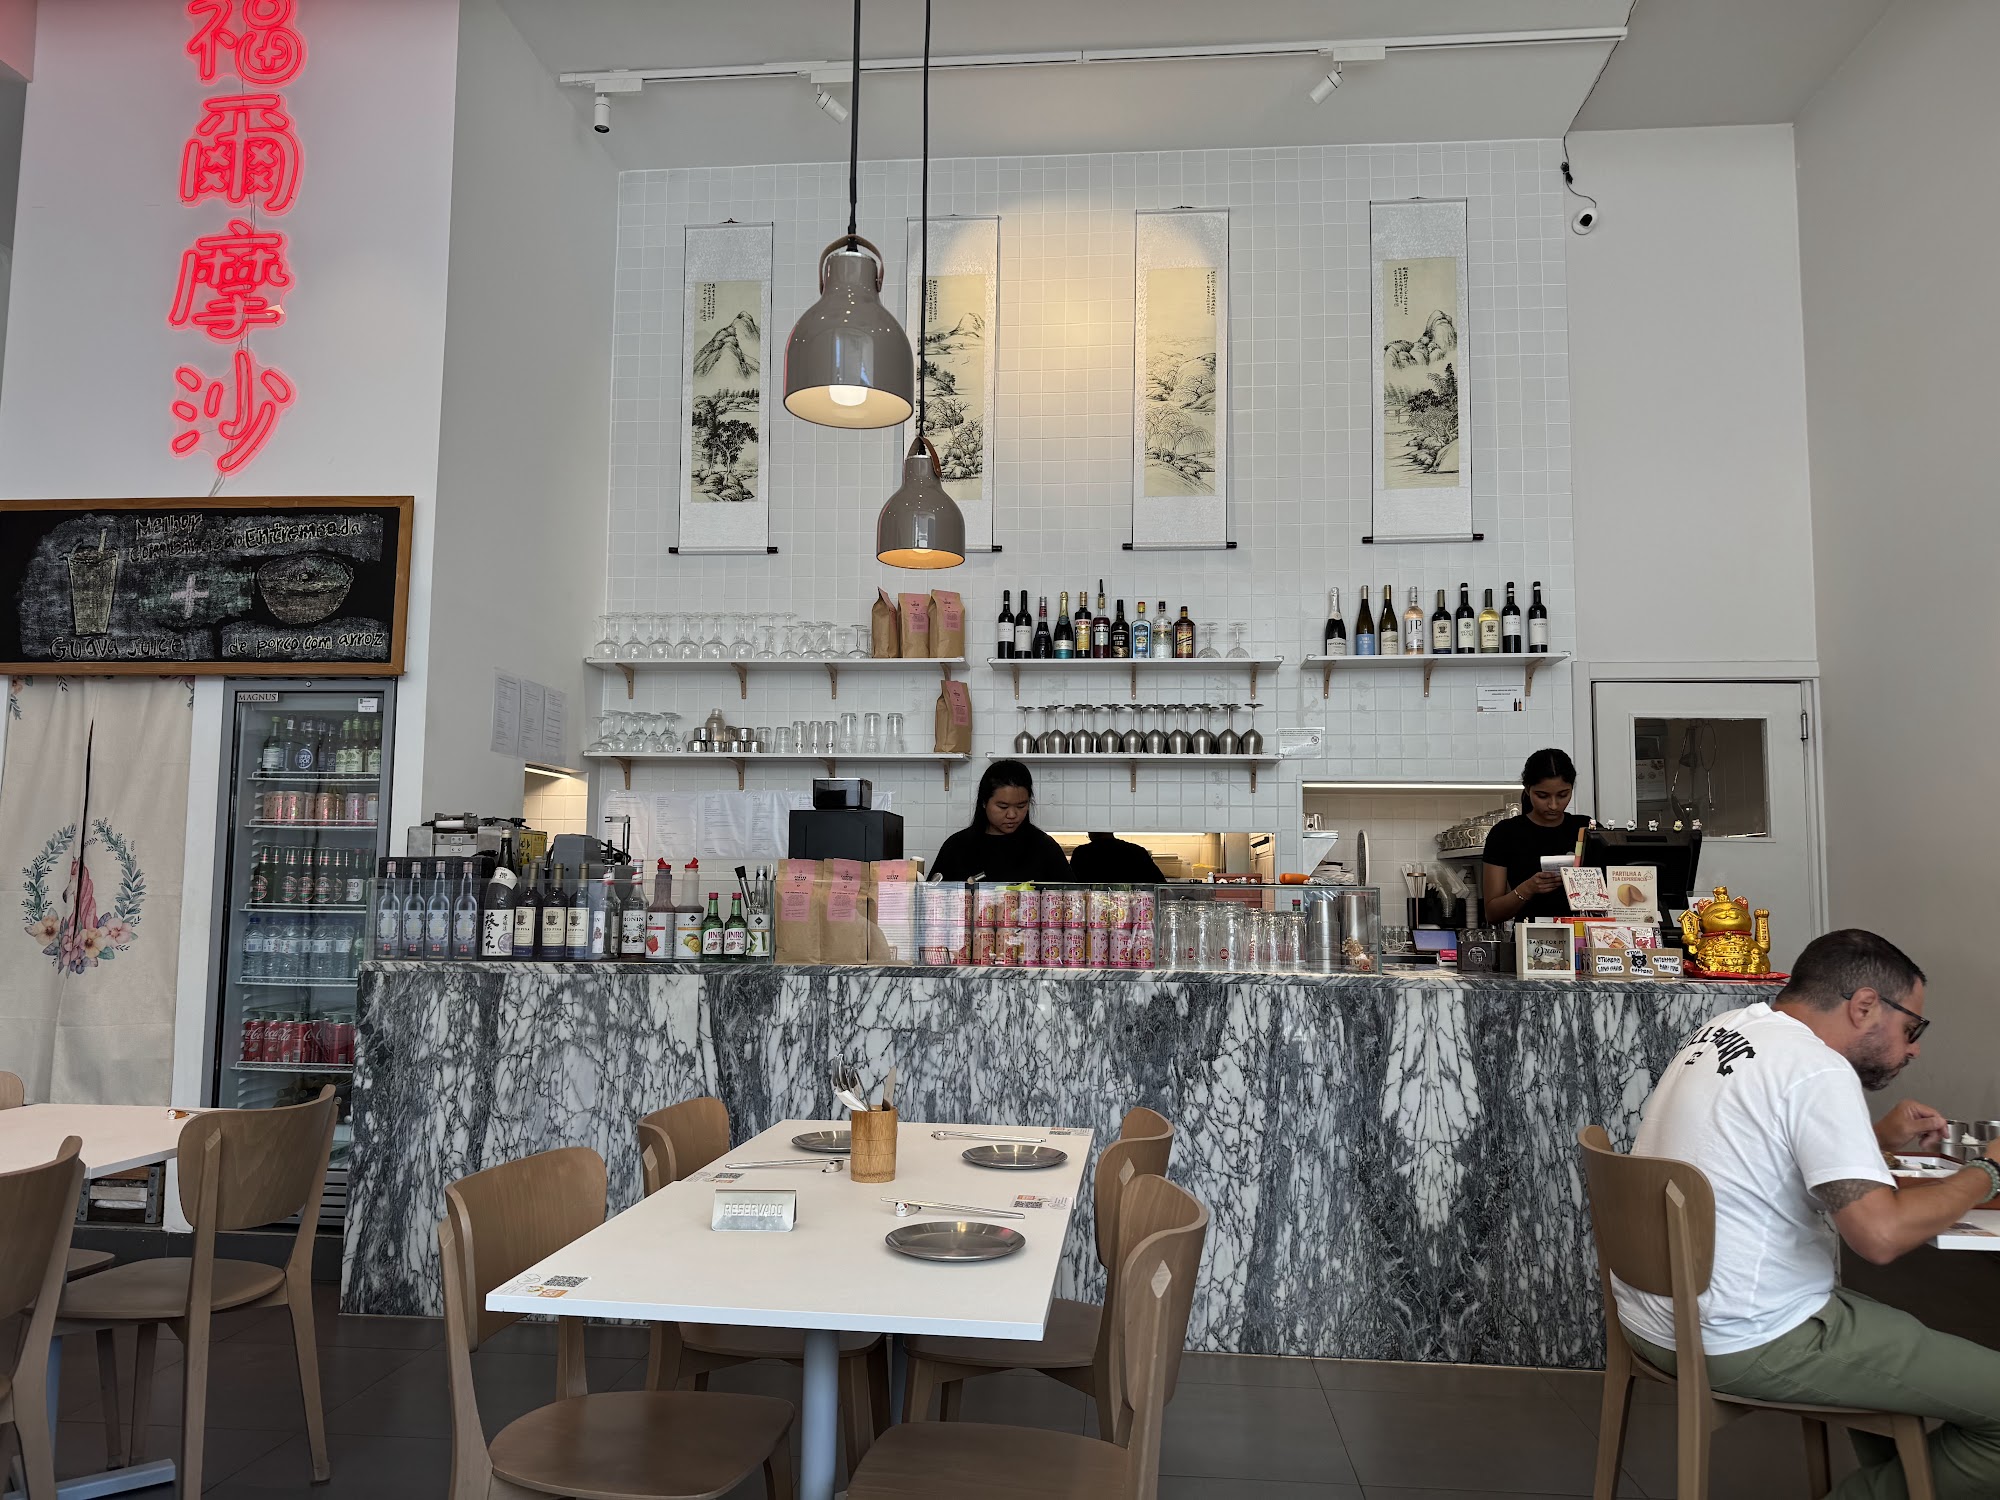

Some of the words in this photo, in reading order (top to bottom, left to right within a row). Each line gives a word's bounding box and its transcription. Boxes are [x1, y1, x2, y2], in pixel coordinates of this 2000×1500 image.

[170, 0, 307, 475] 福爾摩沙
[136, 513, 203, 541] Melhor
[256, 637, 300, 658] porco
[338, 632, 385, 647] arroz
[239, 693, 277, 701] MAGNUS
[708, 931, 723, 940] JINR
[727, 931, 744, 940] JINRO
[723, 1203, 784, 1218] RESERVADO
